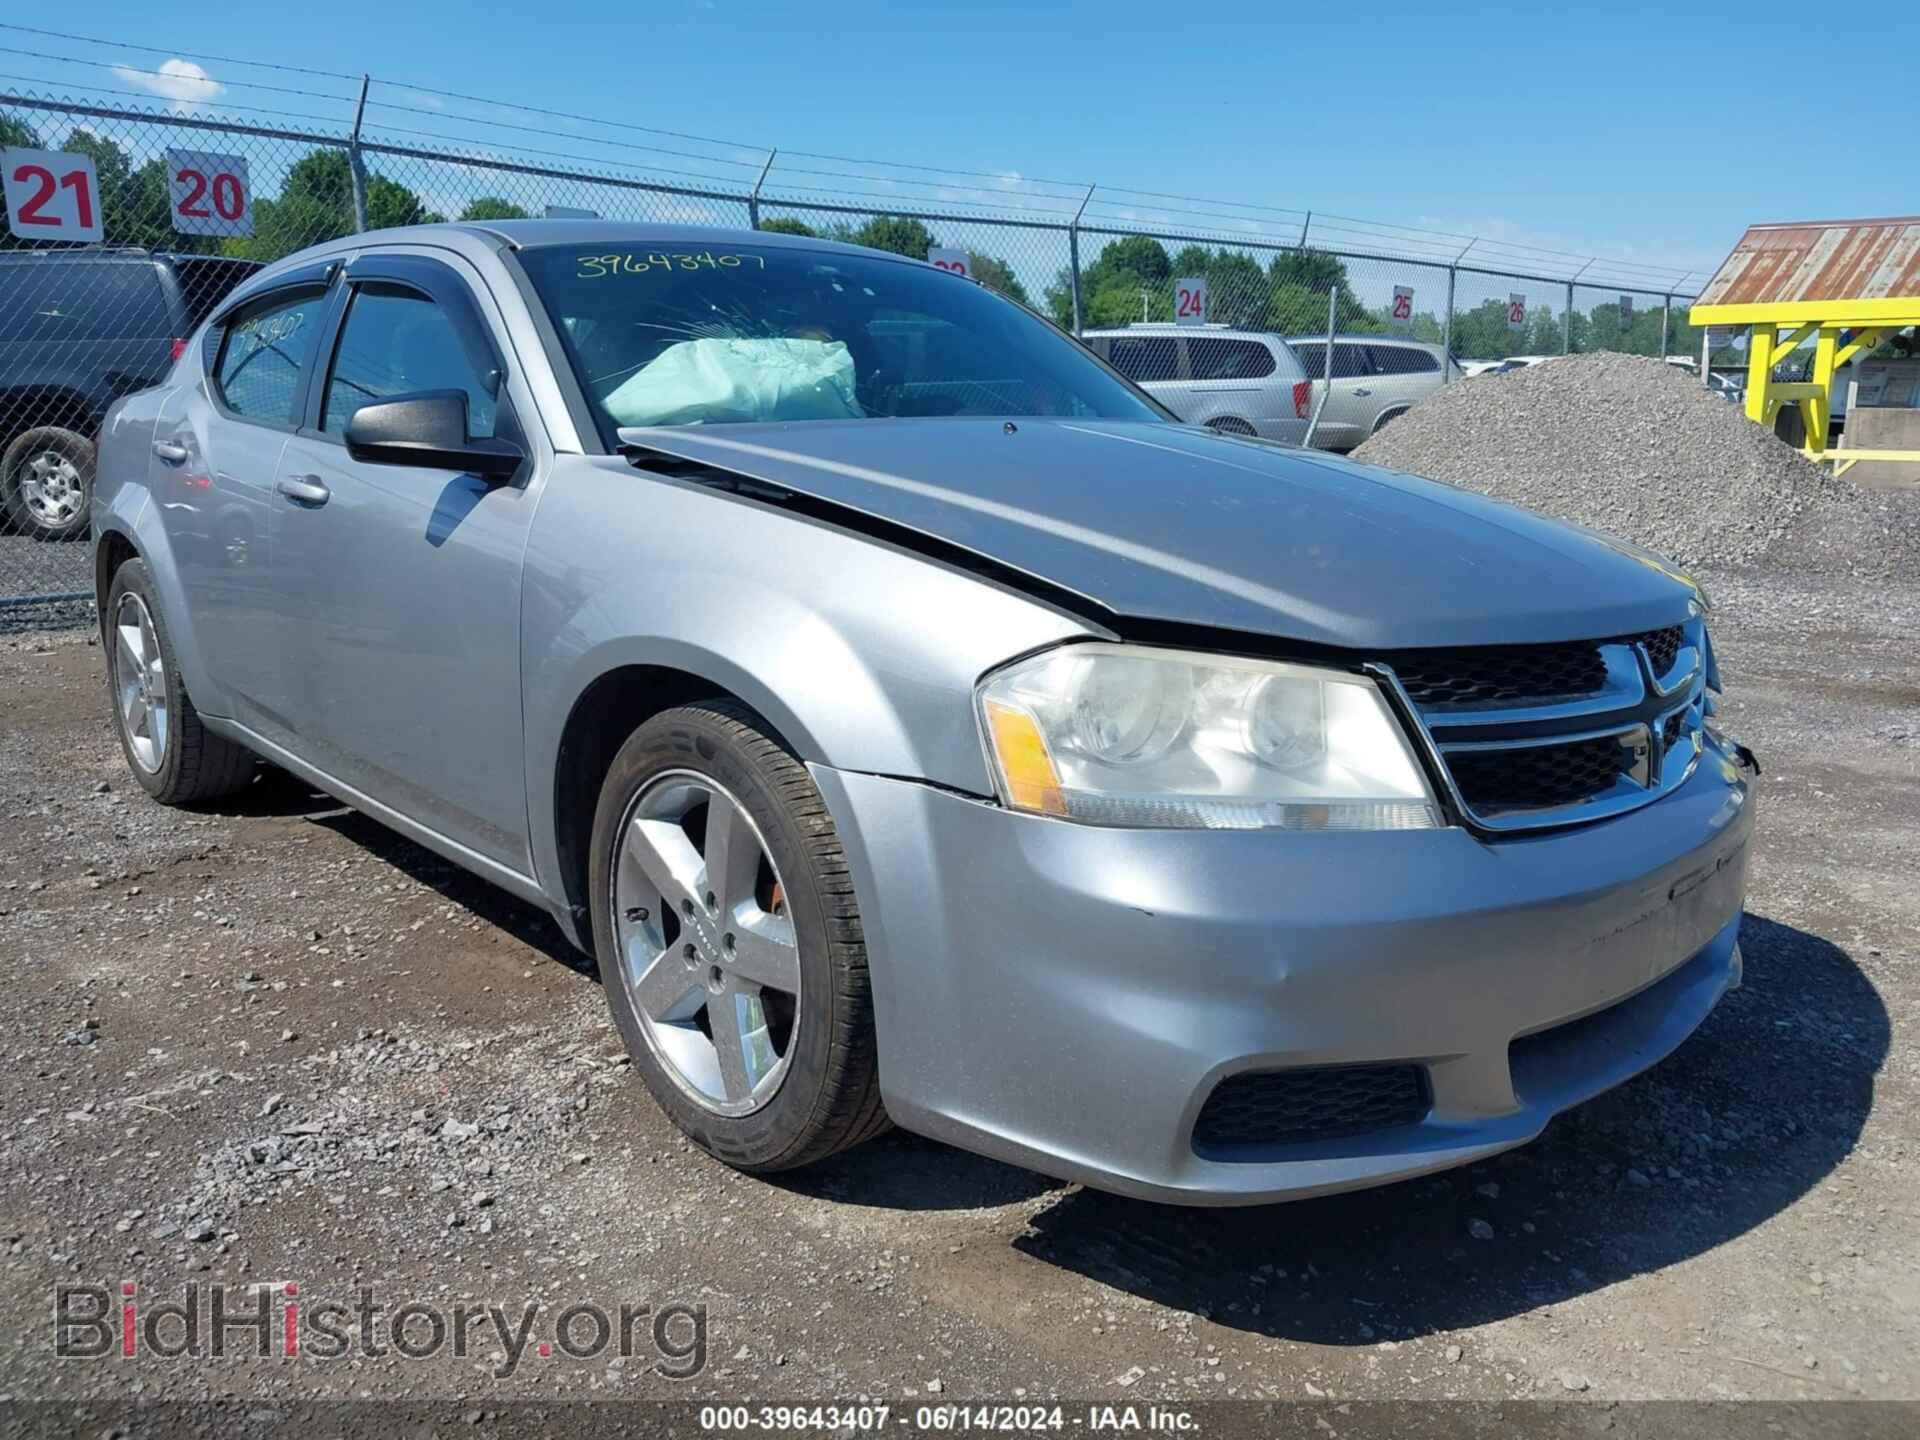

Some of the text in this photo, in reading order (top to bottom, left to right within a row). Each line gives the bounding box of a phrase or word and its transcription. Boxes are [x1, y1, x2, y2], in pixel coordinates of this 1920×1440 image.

[13, 164, 94, 229] 21
[175, 169, 245, 221] 20
[576, 251, 765, 278] 39643407
[1178, 288, 1202, 318] 24
[1392, 293, 1411, 320] 25
[1509, 301, 1524, 323] 26
